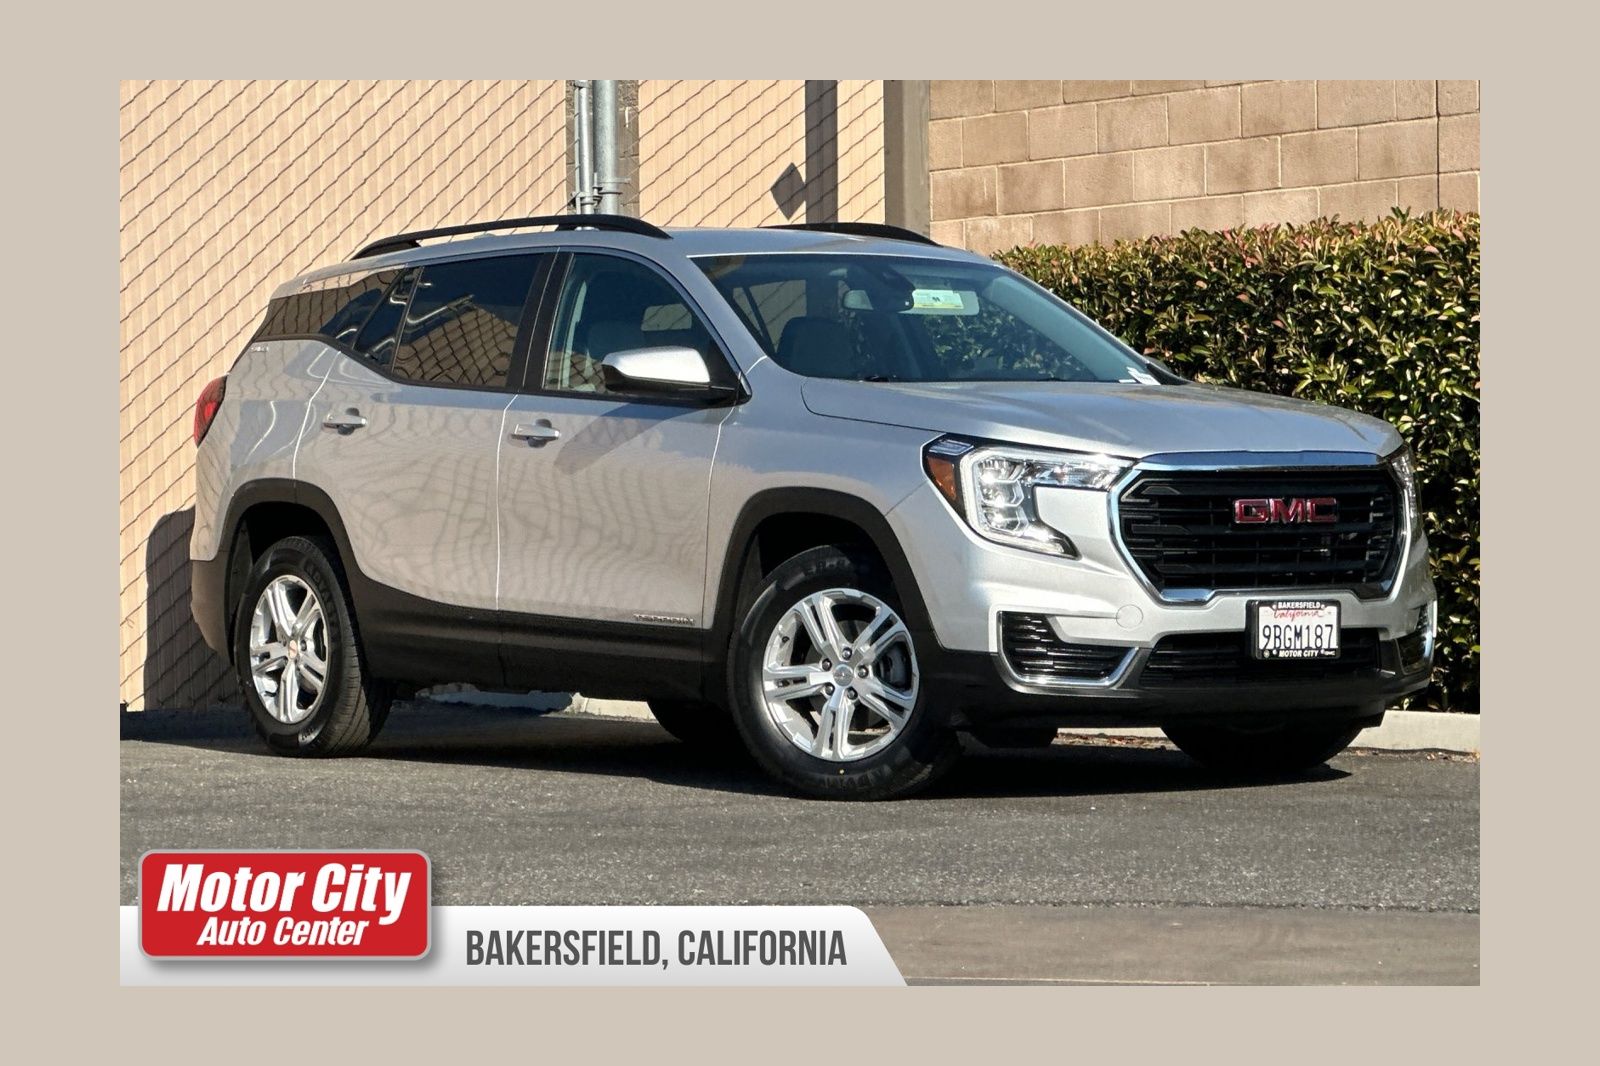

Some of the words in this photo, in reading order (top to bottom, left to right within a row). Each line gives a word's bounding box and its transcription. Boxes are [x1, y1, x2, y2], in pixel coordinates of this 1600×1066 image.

[1234, 498, 1337, 523] GMC
[1277, 601, 1321, 609] BAKERSFIELD
[1273, 609, 1325, 622] California
[1262, 624, 1334, 649] 9BGM187
[1278, 649, 1302, 658] MOTOR
[1303, 649, 1319, 658] CITY
